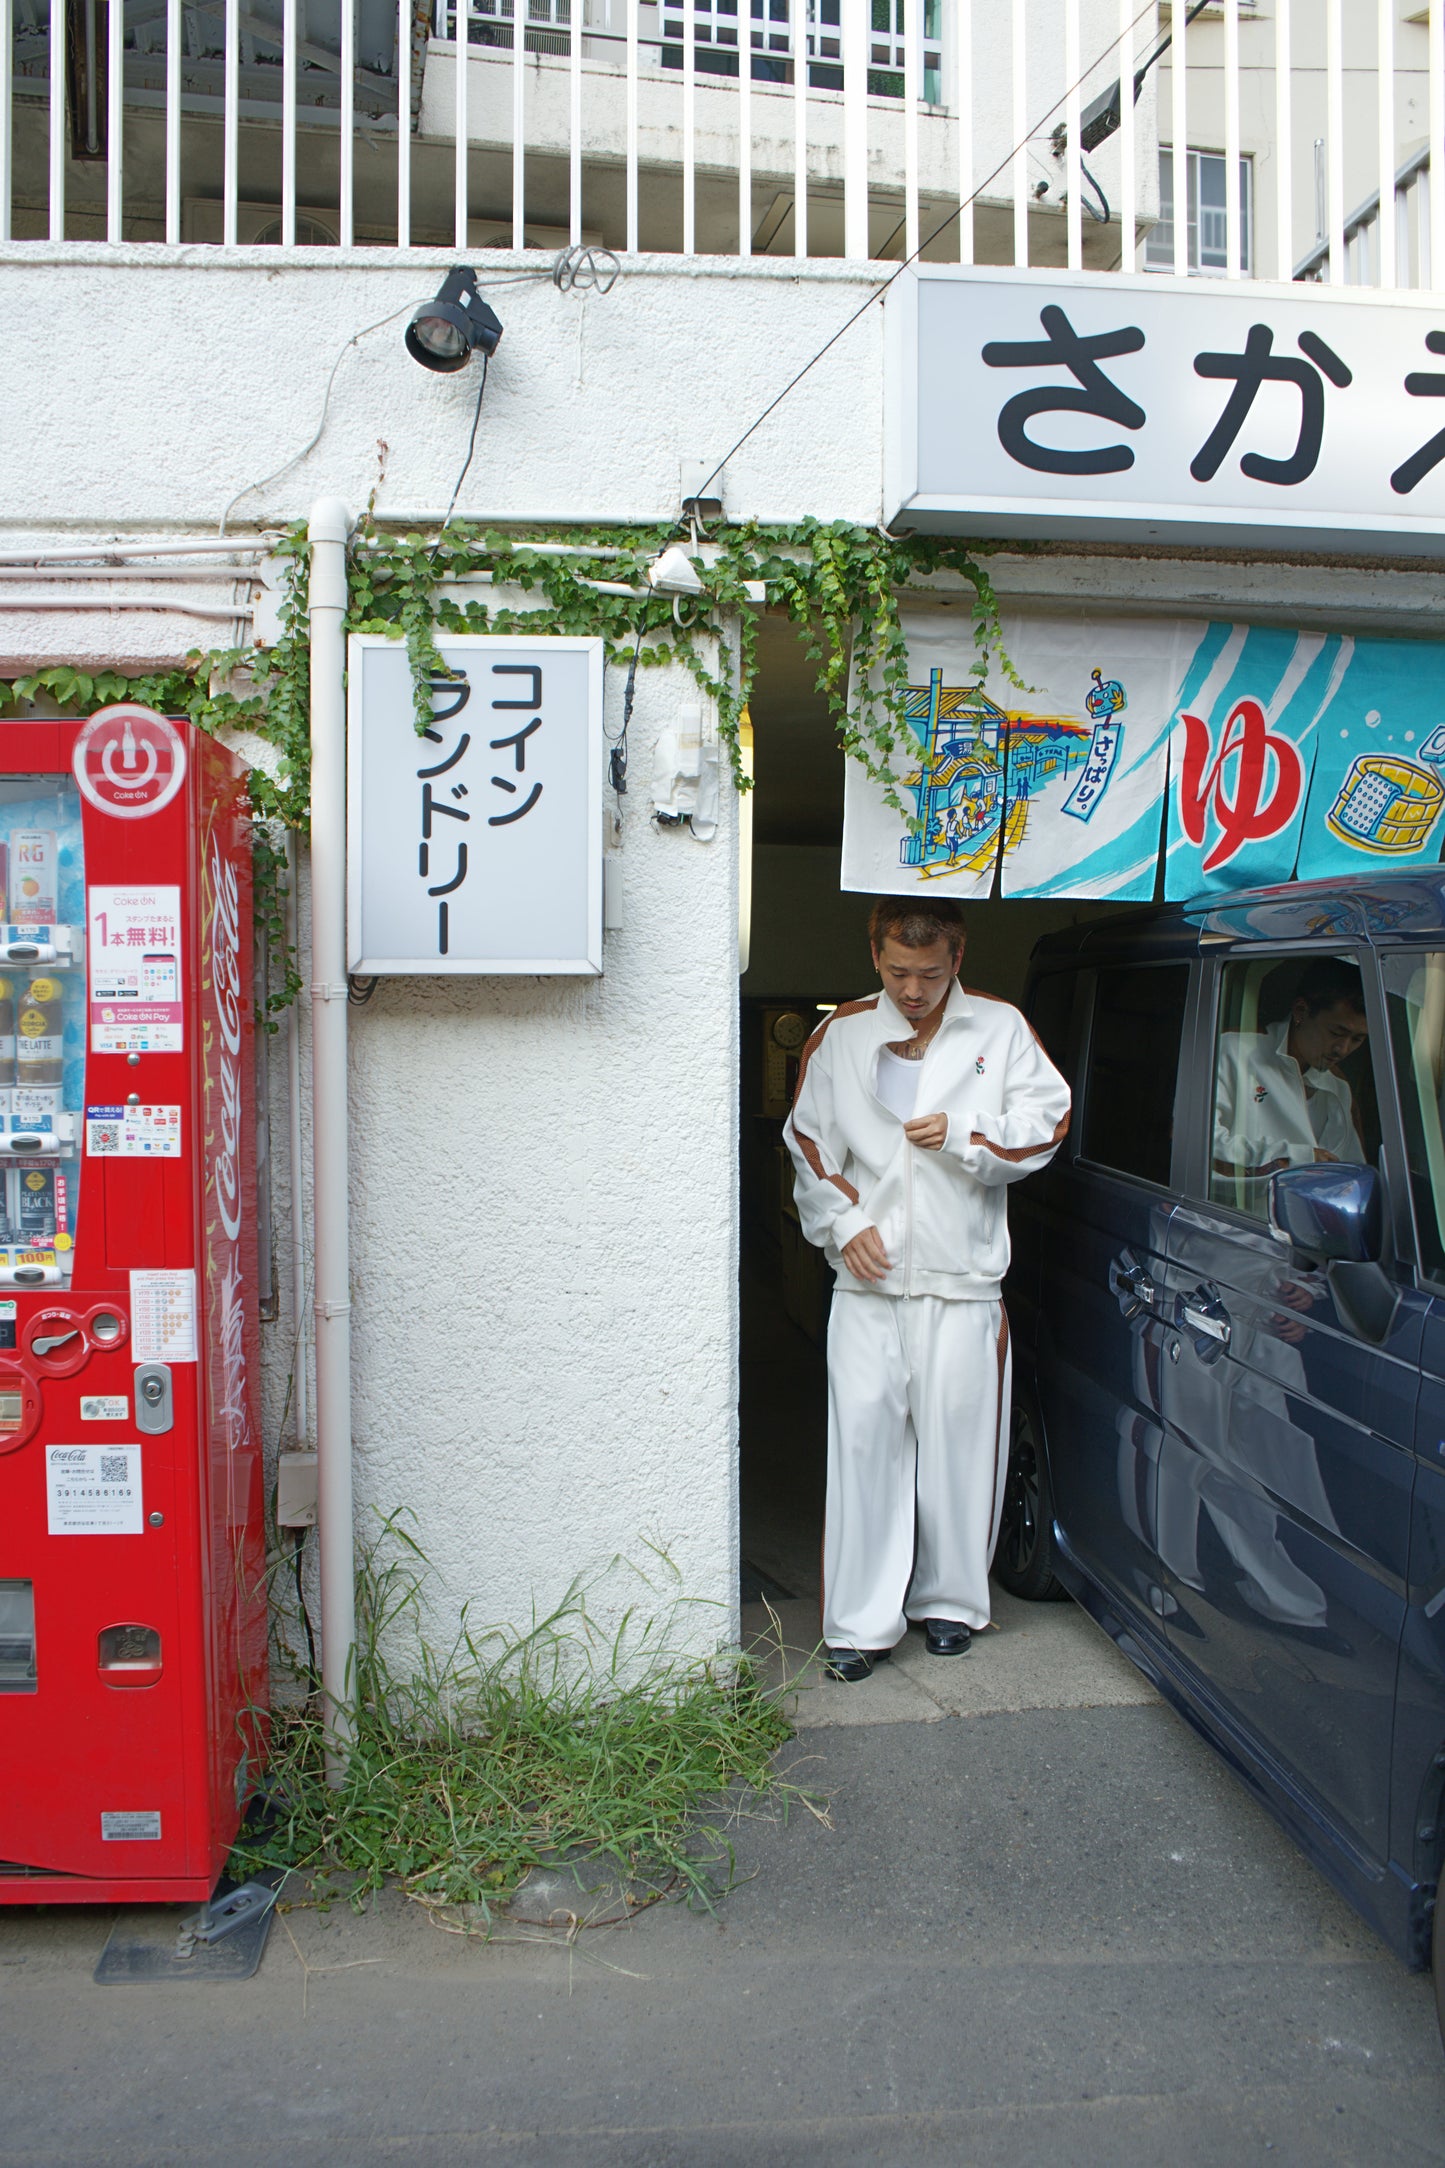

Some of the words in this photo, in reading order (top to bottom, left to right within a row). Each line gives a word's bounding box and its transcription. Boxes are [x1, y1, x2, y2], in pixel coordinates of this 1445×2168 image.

[489, 664, 543, 827] コイン
[1076, 735, 1114, 810] さっぱり。
[1180, 700, 1303, 872] ゆ
[113, 791, 134, 799] Coke
[416, 669, 471, 955] ランドリー
[19, 843, 45, 863] RG
[113, 896, 139, 906] Coke
[140, 896, 156, 905] ON
[95, 912, 175, 947] 1本無料!
[116, 1013, 138, 1021] Coke
[139, 1011, 152, 1021] ON
[153, 1013, 170, 1023] Pay
[29, 1040, 52, 1050] LATTE
[22, 1197, 53, 1208] BLACK
[18, 1252, 53, 1263] 100円
